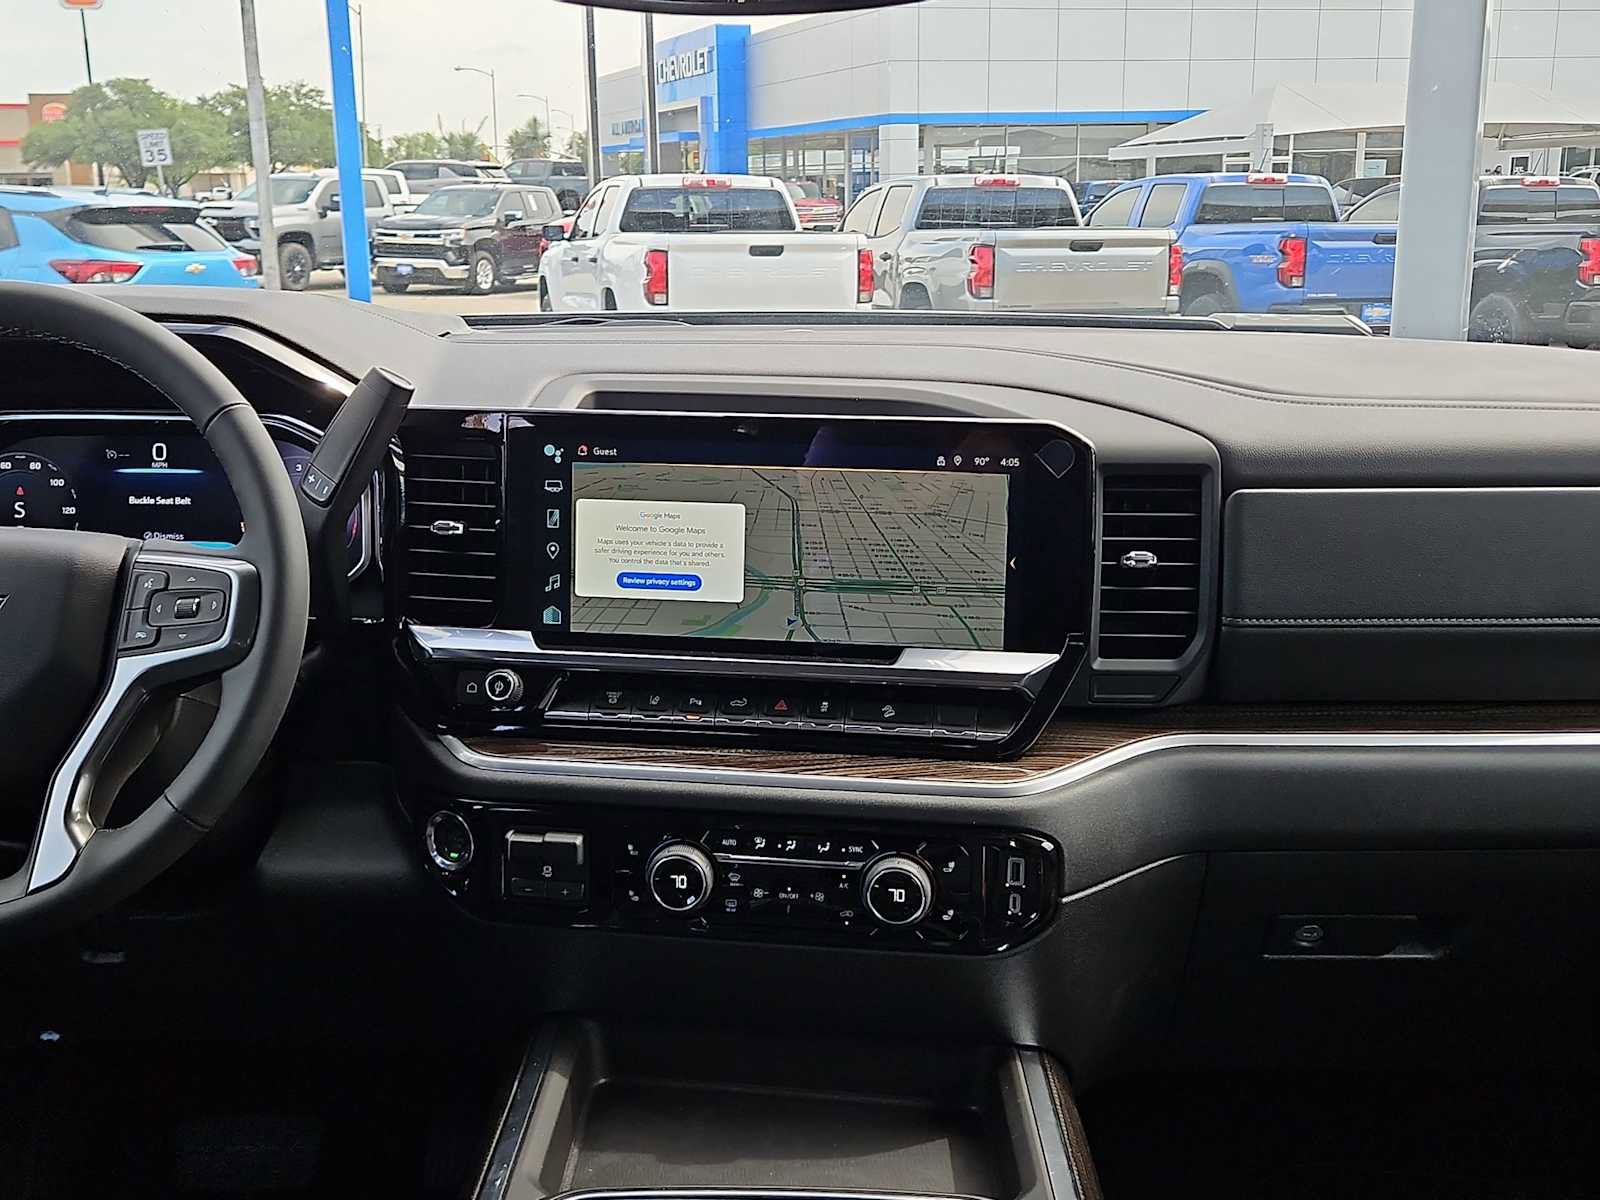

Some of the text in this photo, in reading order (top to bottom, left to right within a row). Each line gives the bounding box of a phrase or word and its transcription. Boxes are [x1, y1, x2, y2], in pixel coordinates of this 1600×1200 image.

[657, 47, 711, 85] CHEVROLET
[145, 148, 169, 162] 35
[152, 443, 167, 461] 0
[593, 446, 617, 456] Guest
[974, 457, 990, 466] 90°
[1000, 458, 1020, 467] 4:05
[129, 496, 192, 505] Buckle Seat Belt
[14, 501, 26, 518] S
[663, 512, 681, 520] Maps
[616, 524, 648, 533] Welcome
[659, 525, 685, 535] Google
[686, 527, 706, 535] Maps
[153, 532, 184, 540] Dismiss
[597, 537, 613, 545] Maps
[673, 540, 687, 548] data
[695, 541, 718, 549] provide
[594, 546, 610, 554] safer
[611, 547, 633, 556] driving
[622, 576, 696, 588] Review privacy settings
[670, 875, 687, 889] 70
[888, 888, 905, 902] 70
